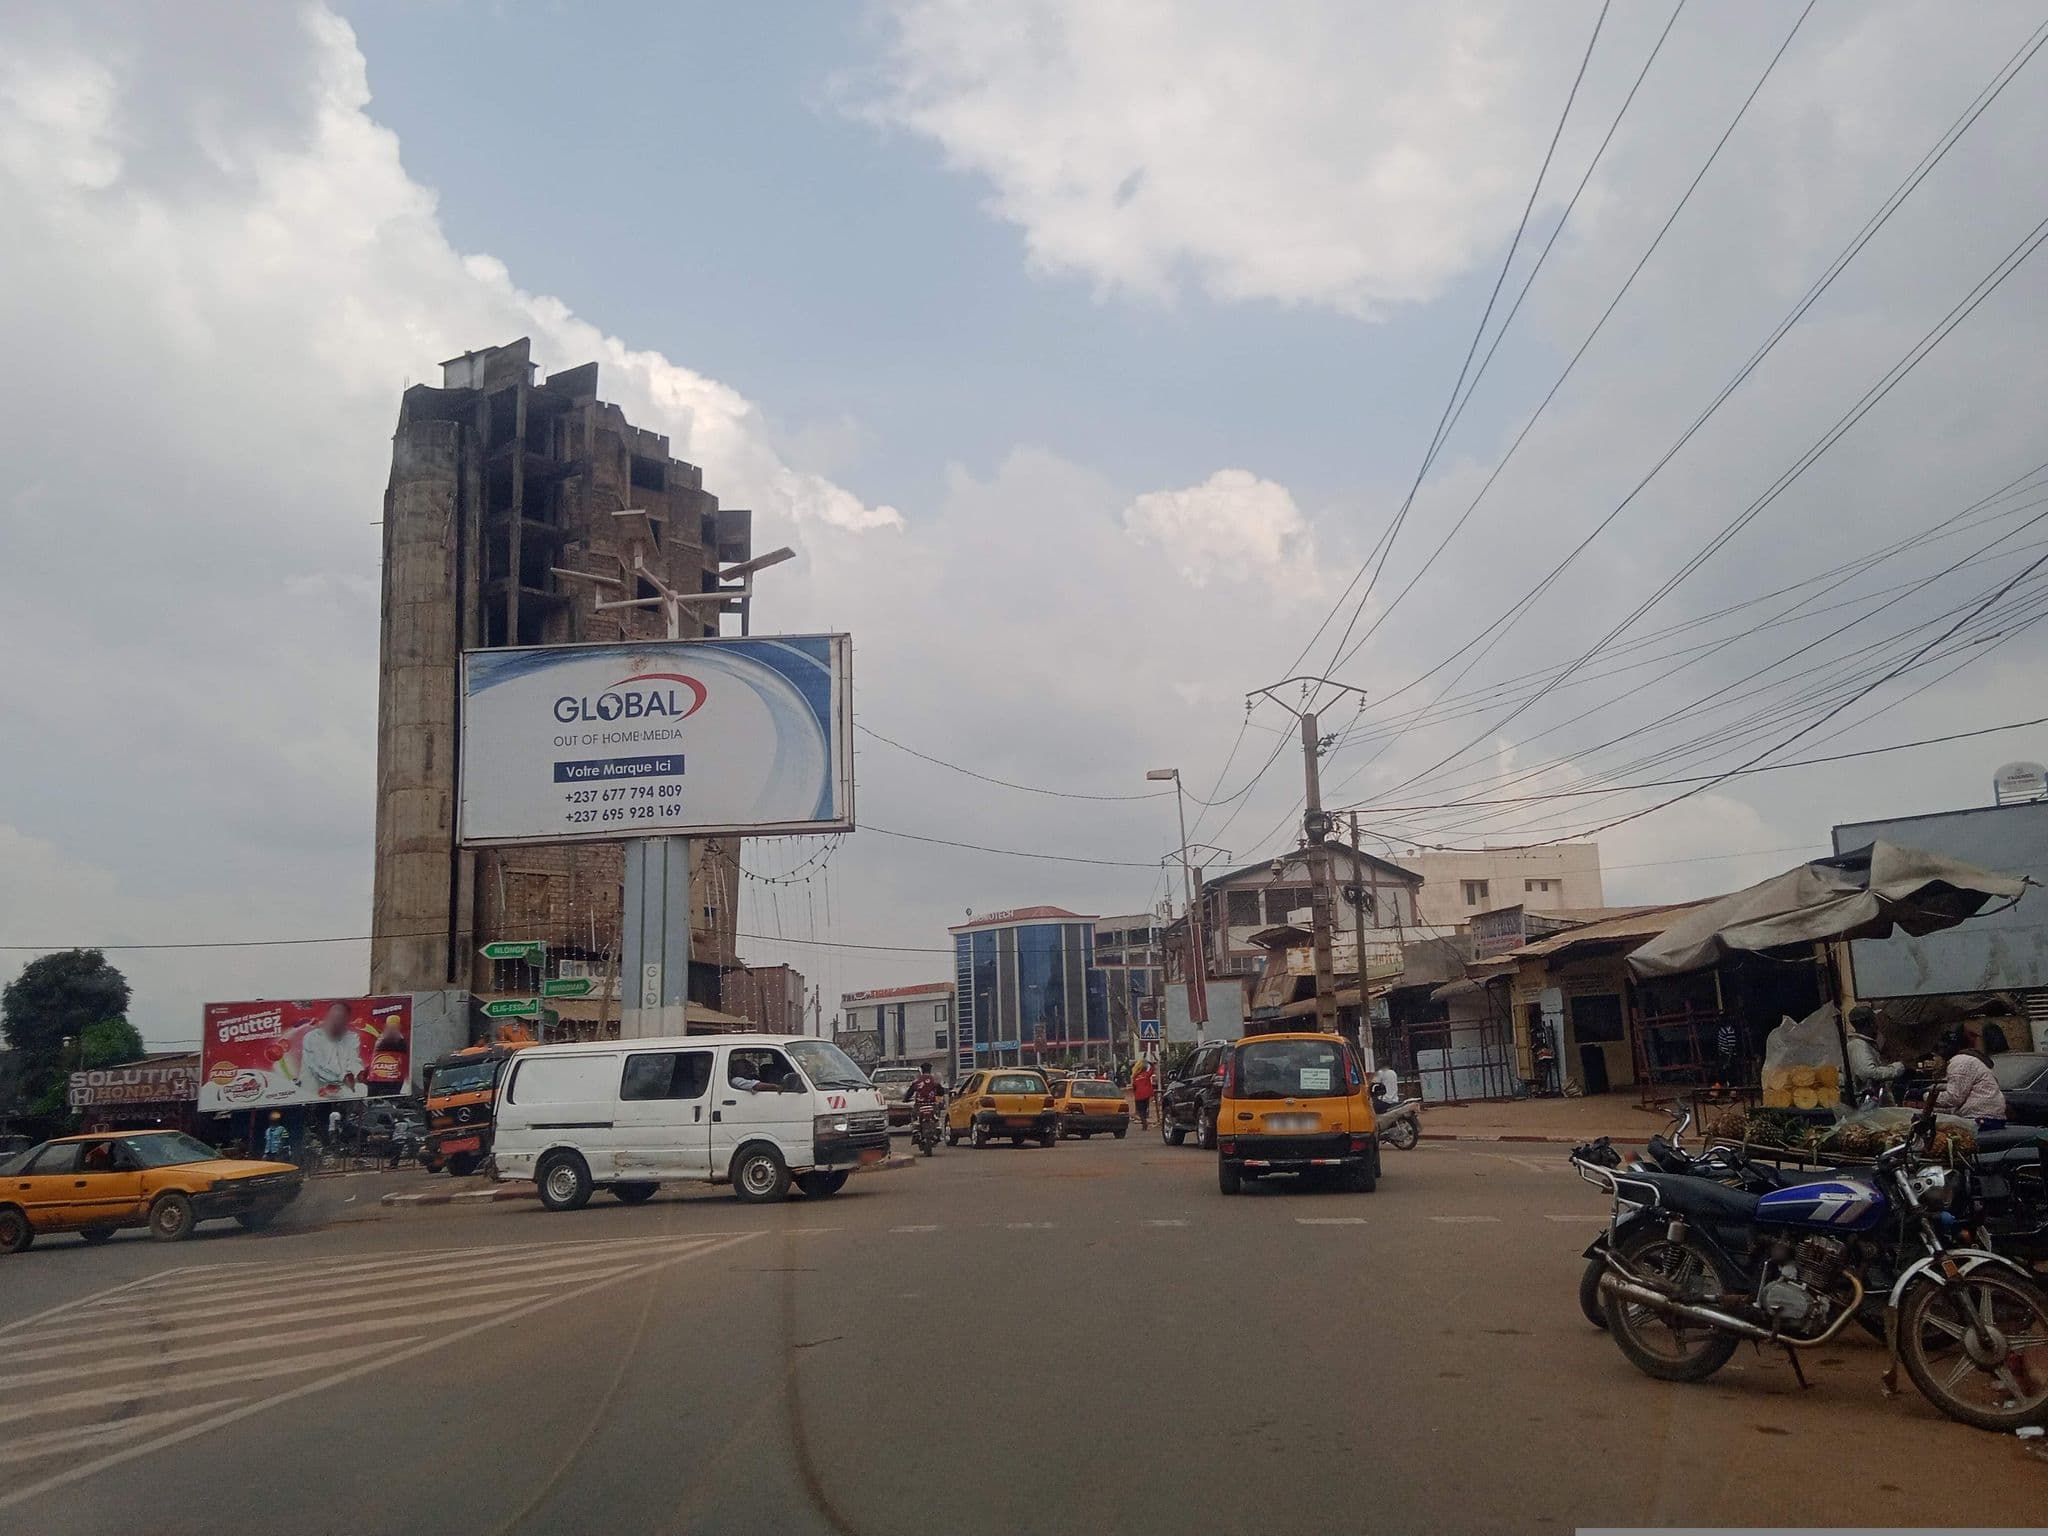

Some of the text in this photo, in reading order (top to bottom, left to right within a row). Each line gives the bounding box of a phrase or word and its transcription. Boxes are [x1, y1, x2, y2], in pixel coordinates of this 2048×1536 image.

[554, 689, 684, 723] GLOBAL
[553, 729, 683, 747] OUT OF HOME MEDIA
[566, 759, 672, 779] Votre Marque Ici
[565, 784, 683, 803] +237 677 794 809
[565, 803, 682, 823] +237 695 928 169
[218, 1015, 282, 1043] gouttez
[95, 1086, 170, 1098] HONDA
